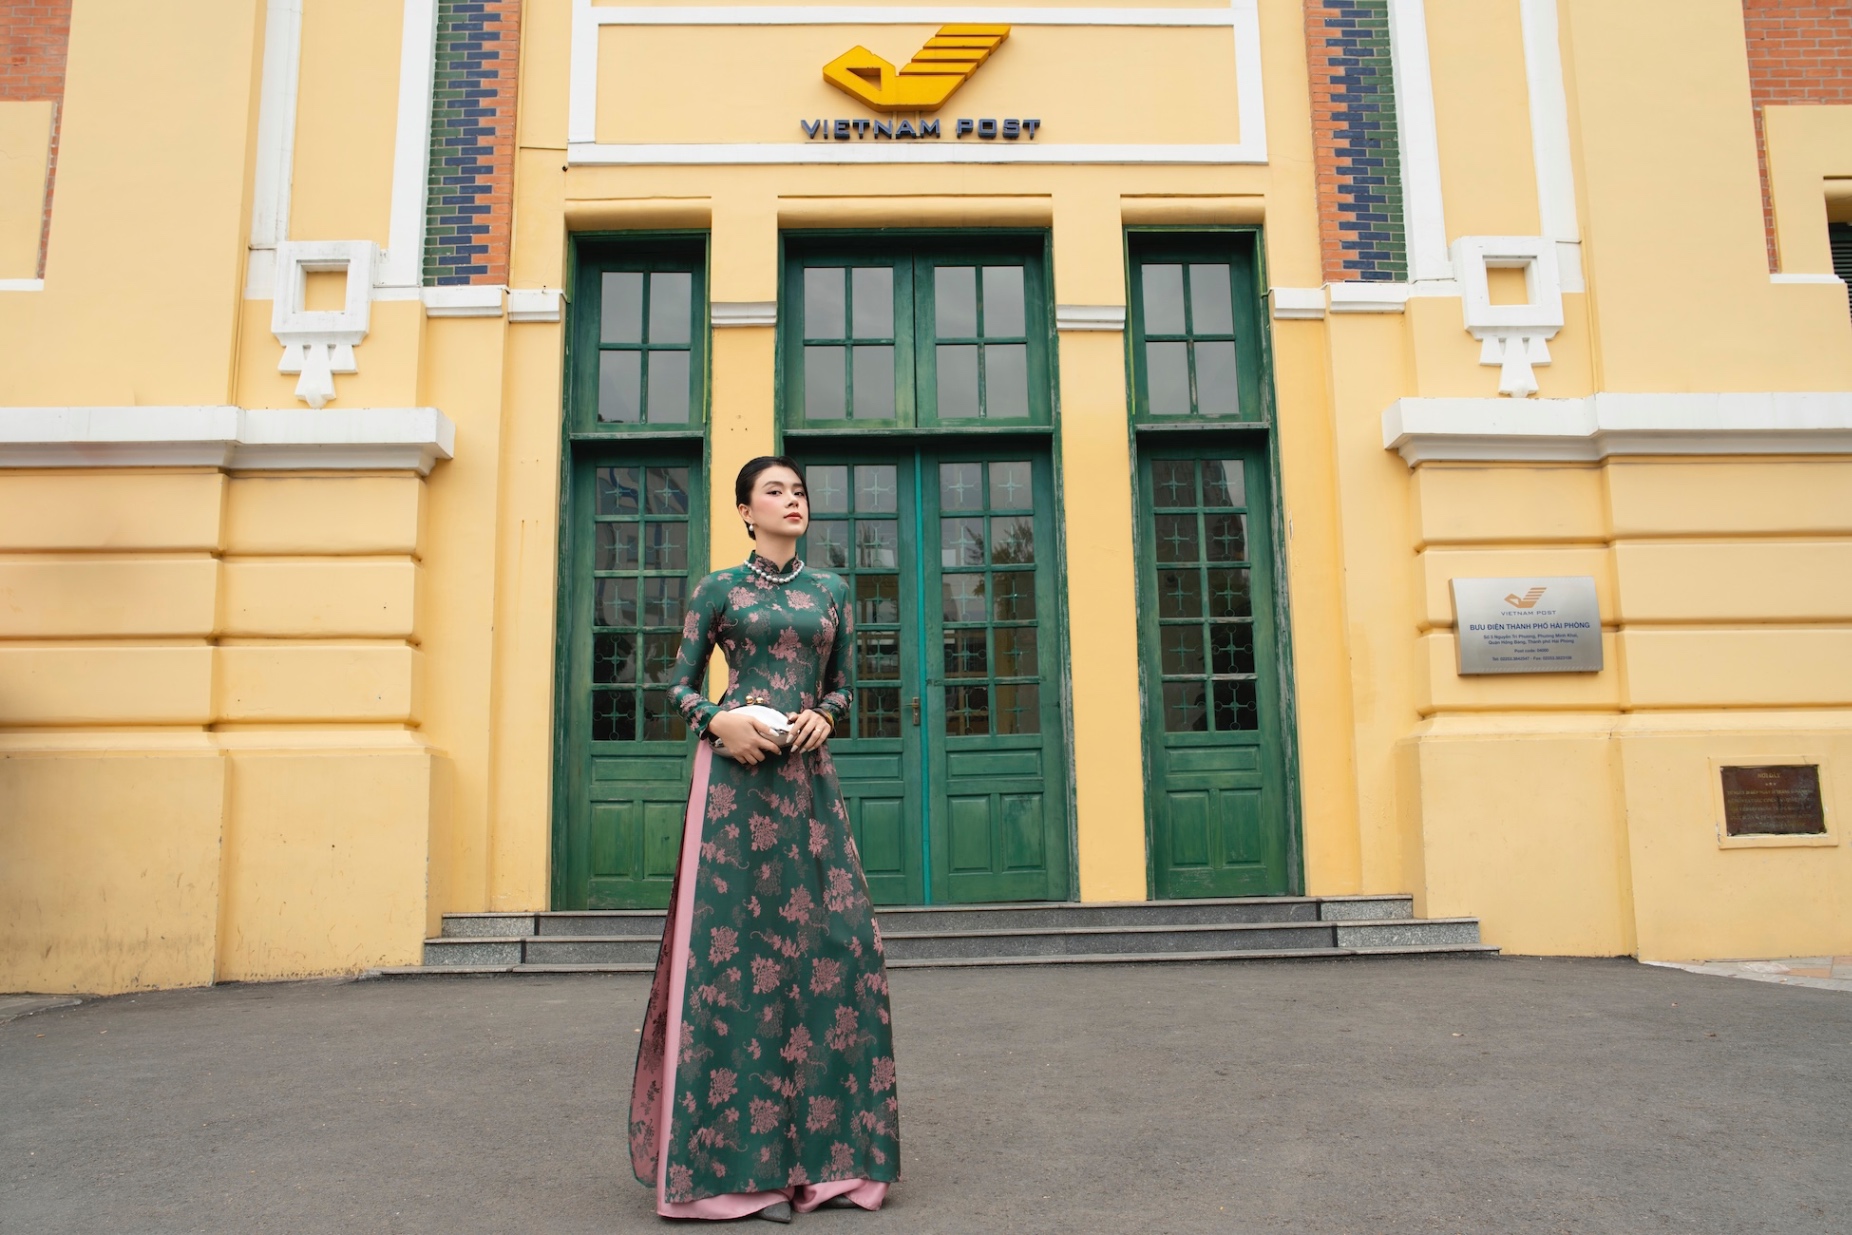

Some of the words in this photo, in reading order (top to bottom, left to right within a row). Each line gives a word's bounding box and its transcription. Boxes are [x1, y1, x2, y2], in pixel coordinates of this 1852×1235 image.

[800, 119, 941, 140] VIETNAM
[956, 118, 1041, 139] POST
[1506, 622, 1532, 630] THÀNH
[1533, 621, 1548, 630] PHỐ
[1564, 621, 1590, 629] PHÒNG
